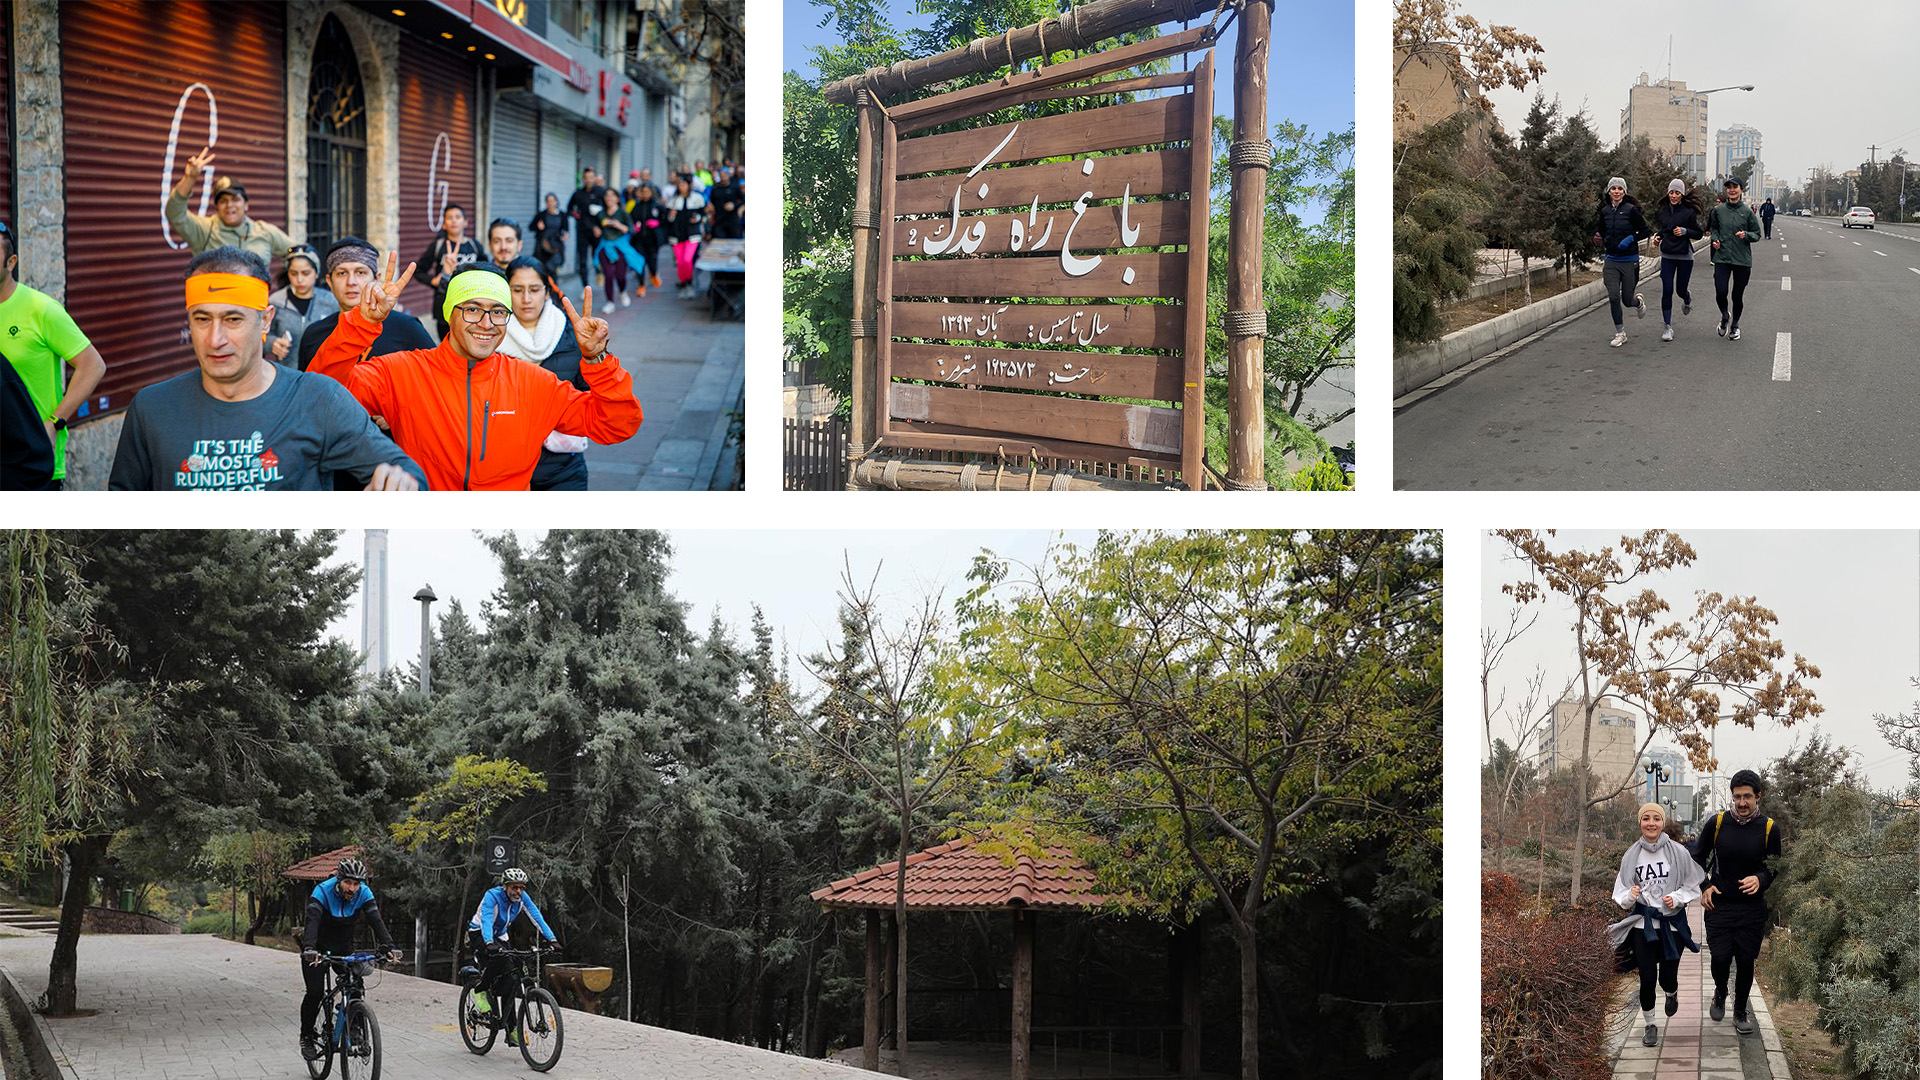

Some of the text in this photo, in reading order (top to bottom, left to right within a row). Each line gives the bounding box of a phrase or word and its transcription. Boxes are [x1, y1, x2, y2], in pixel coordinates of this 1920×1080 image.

[427, 131, 451, 233] G
[1010, 194, 1054, 252] راه
[908, 228, 918, 246] 2
[941, 314, 973, 334] ۱۳۹۳
[976, 305, 1009, 340] آبان
[1078, 312, 1110, 346] سال
[193, 439, 264, 454] IT'S THE
[203, 454, 254, 471] MOST
[175, 467, 284, 487] RUNDERFUL
[1634, 861, 1669, 882] YAL
